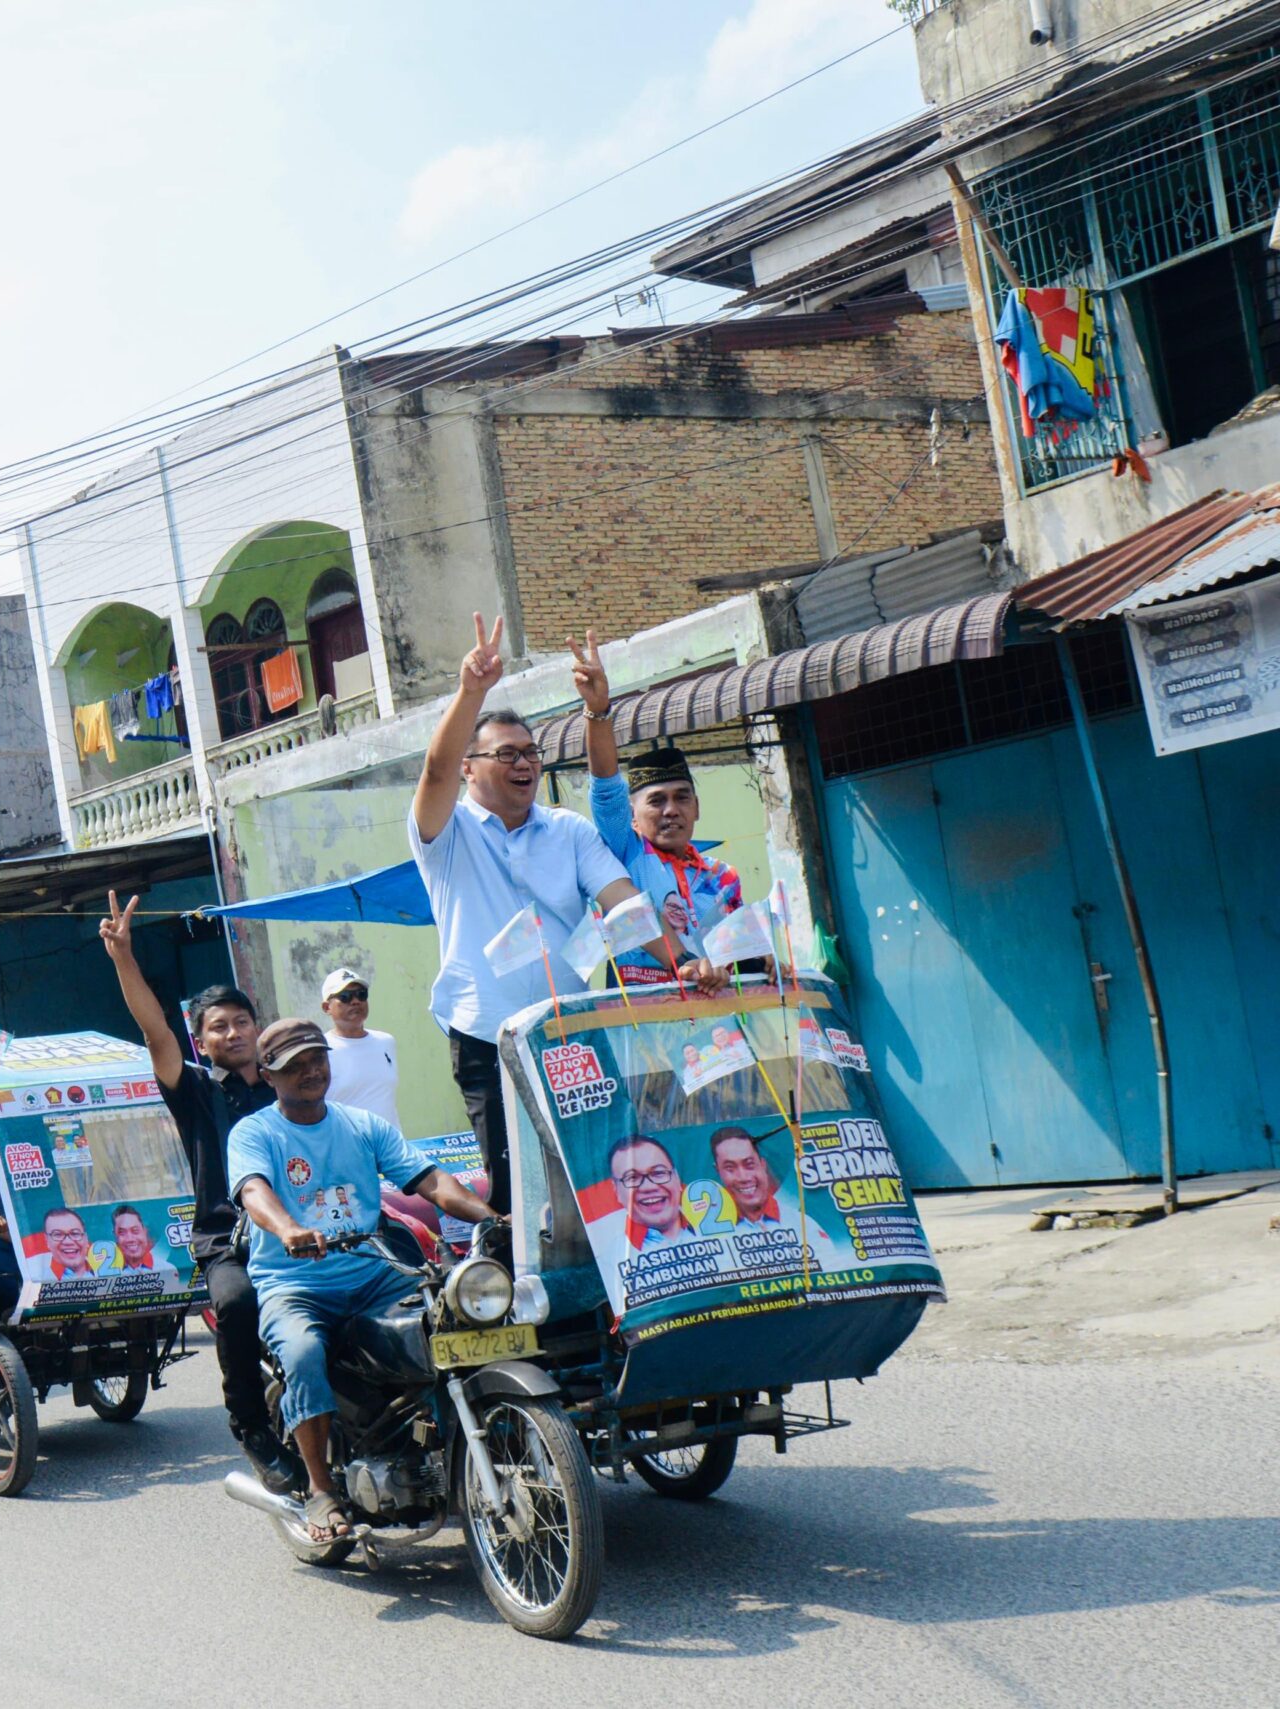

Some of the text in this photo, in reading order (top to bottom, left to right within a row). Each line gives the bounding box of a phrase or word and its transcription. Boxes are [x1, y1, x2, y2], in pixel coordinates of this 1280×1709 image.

[1163, 607, 1220, 630] WallPaper
[1182, 702, 1237, 724] Wall Panel
[549, 1055, 589, 1074] 27 NOV
[552, 1065, 597, 1090] 2024
[556, 1080, 615, 1104] DATANG
[560, 1093, 609, 1116] KE TPS
[443, 1137, 457, 1147] 02
[13, 1158, 40, 1171] 2024
[13, 1169, 52, 1181] DATANG
[15, 1178, 48, 1189] KE TPS
[833, 1177, 906, 1208] SEHAT
[331, 1209, 341, 1220] 2
[734, 1229, 797, 1251] LOM LOM
[621, 1239, 722, 1279] H. ASRI LUDIN
[741, 1246, 813, 1266] SUWONDO
[54, 1281, 77, 1290] ASRI
[76, 1279, 106, 1289] LUDIN
[113, 1281, 164, 1293] SUWONDO
[623, 1258, 719, 1294] TAMBUNAN
[627, 1288, 661, 1306] CALON
[661, 1280, 694, 1296] BUPATI
[694, 1275, 714, 1288] DAN
[714, 1272, 740, 1285] WAKIL
[740, 1267, 769, 1280] BUPATI
[769, 1264, 785, 1275] DELI
[740, 1269, 875, 1299] RELAWAN ASLI LO
[40, 1289, 96, 1300] TAMBUNAN
[99, 1297, 152, 1309] RELAWAN
[153, 1294, 178, 1304] ASLI
[638, 1311, 711, 1341] MASYARAKAT
[711, 1303, 761, 1321] PERUMNAS
[760, 1296, 807, 1312] MANDALA
[806, 1290, 843, 1302] BERSATU
[843, 1286, 910, 1300] MEMENANGKAN
[462, 1332, 503, 1358] 1272
